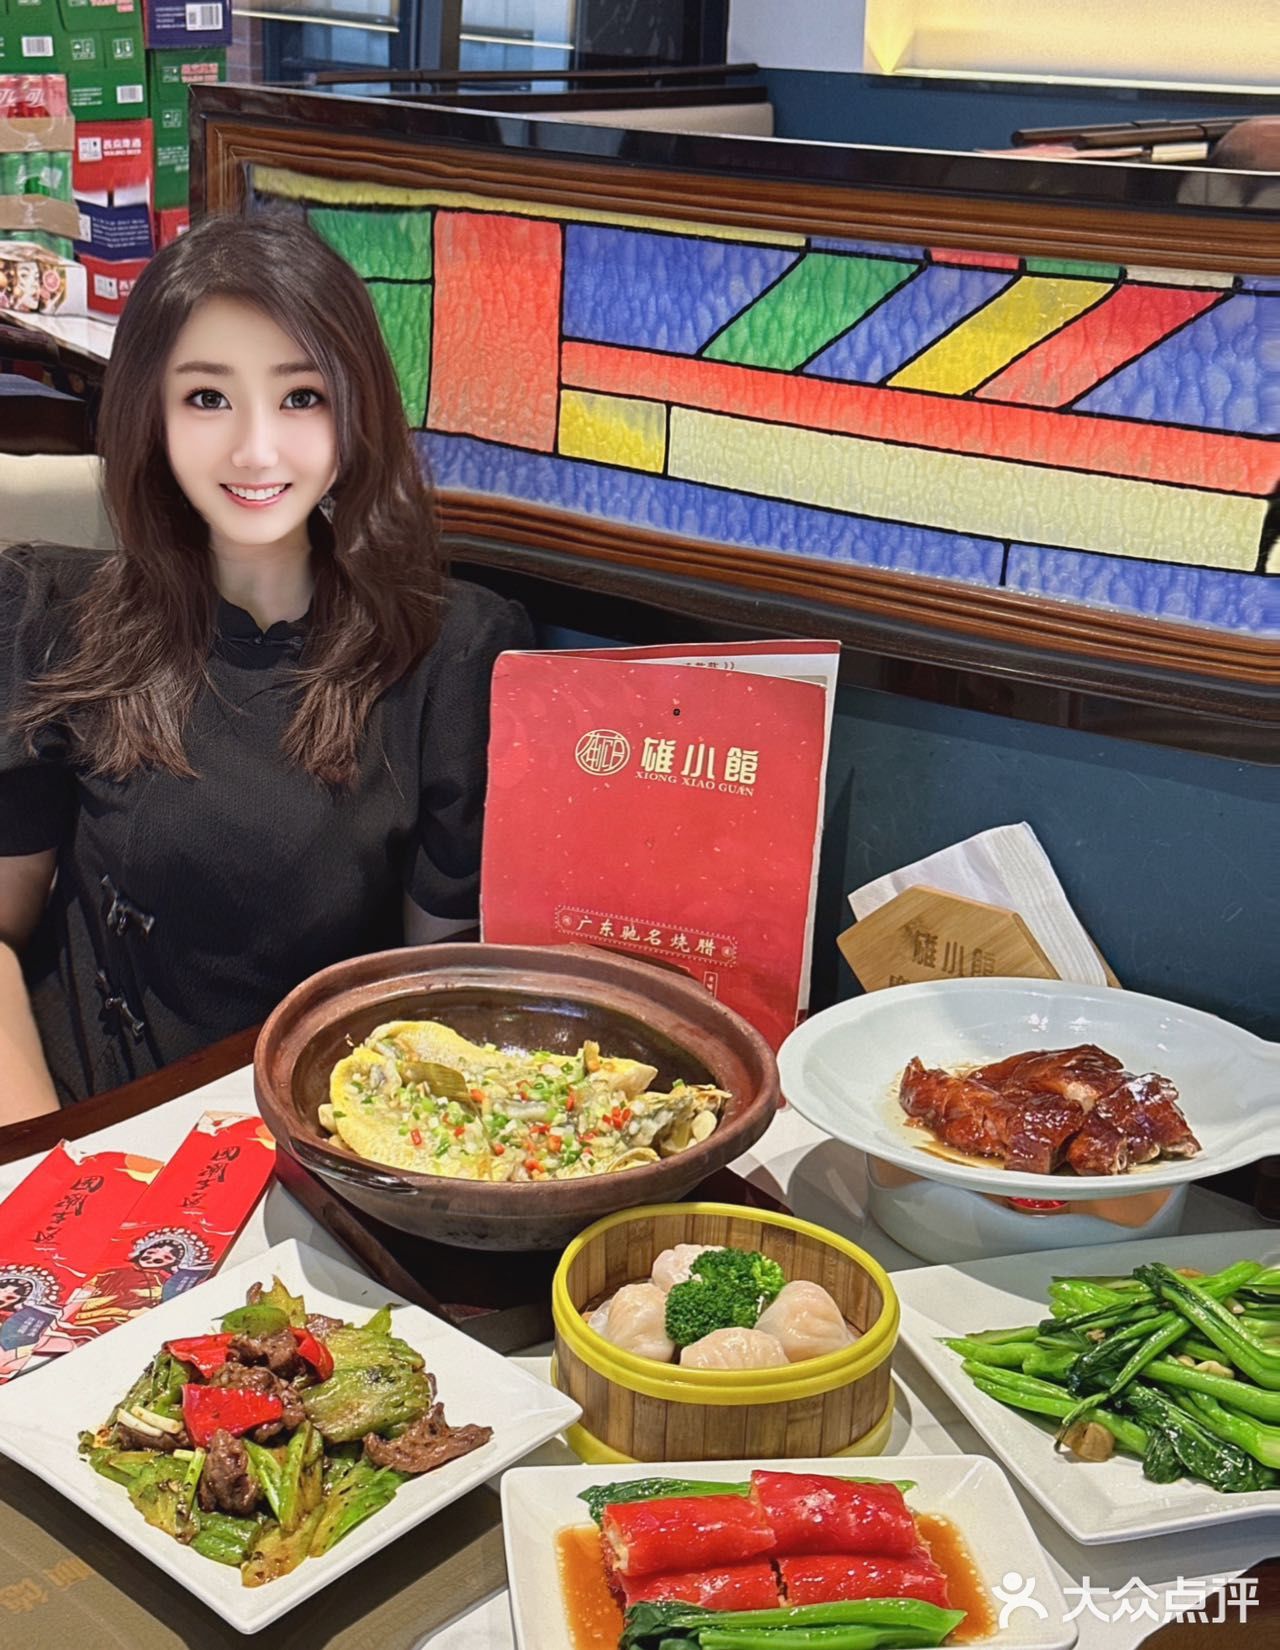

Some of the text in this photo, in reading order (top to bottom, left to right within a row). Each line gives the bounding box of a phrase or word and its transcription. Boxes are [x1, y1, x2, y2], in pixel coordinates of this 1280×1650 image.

[635, 771, 755, 797] XIONG XIAO GUAN
[576, 915, 716, 958] 广东驰名烧腊
